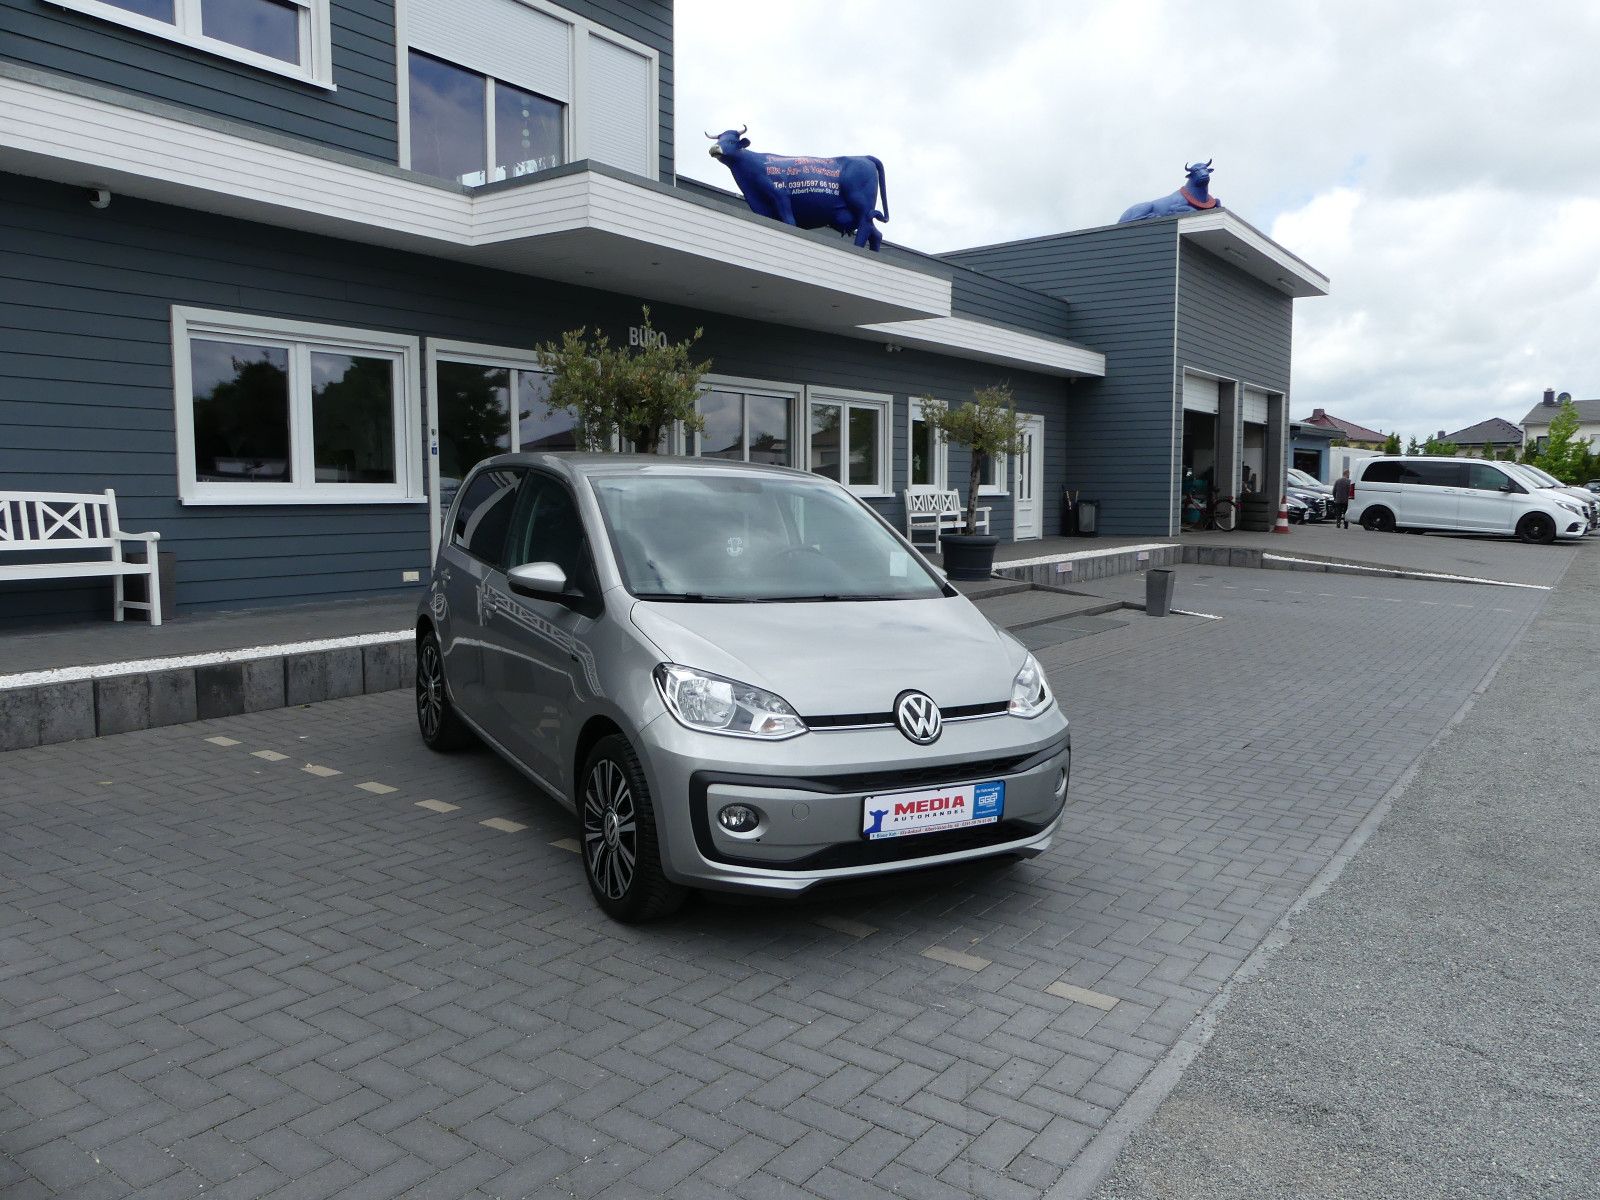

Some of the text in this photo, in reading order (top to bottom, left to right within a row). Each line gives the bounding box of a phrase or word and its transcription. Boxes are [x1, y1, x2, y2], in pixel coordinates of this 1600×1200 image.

[629, 325, 667, 349] BÜRO
[894, 795, 965, 815] MEDIA
[894, 809, 966, 822] AUTOHANDEL
